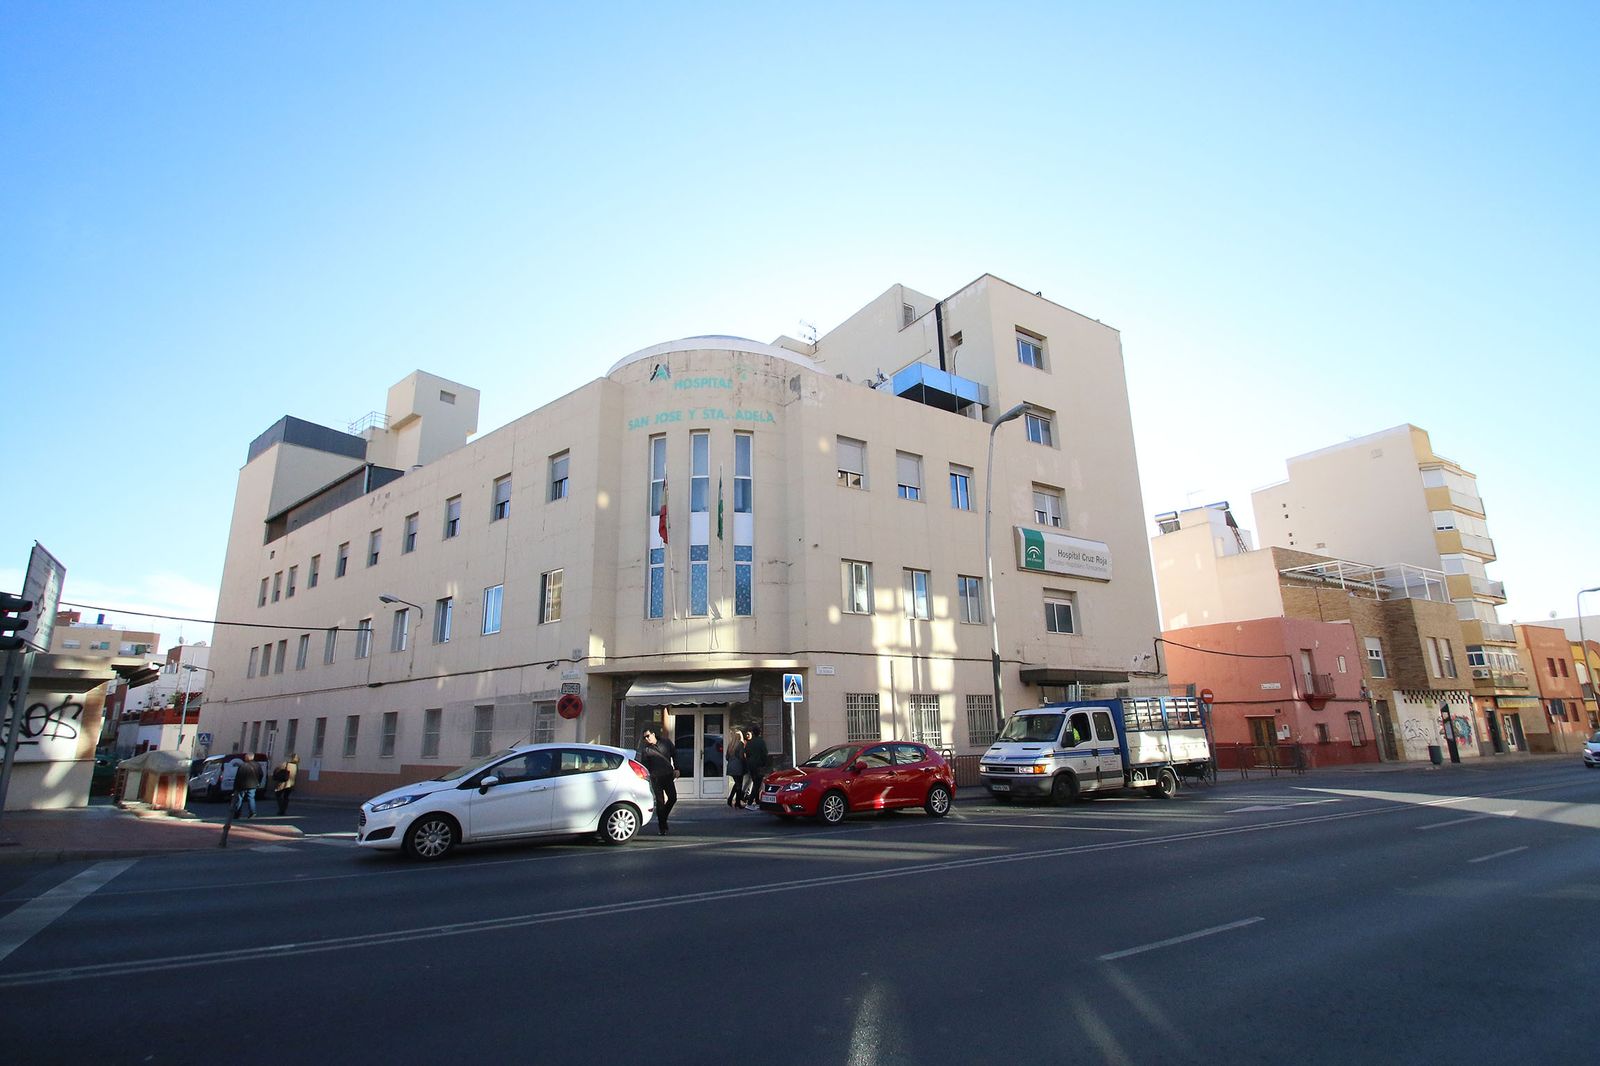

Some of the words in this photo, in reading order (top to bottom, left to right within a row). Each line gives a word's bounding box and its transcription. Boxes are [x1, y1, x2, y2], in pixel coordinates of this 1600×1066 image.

[674, 376, 733, 390] HOSPITAL
[628, 416, 649, 431] SAN
[655, 409, 682, 424] JOSE
[687, 408, 697, 420] Y
[703, 408, 730, 421] STA.
[735, 408, 776, 425] ADELA
[1057, 549, 1081, 561] Hospital
[1081, 553, 1094, 563] Cruz
[1095, 555, 1108, 566] Roja
